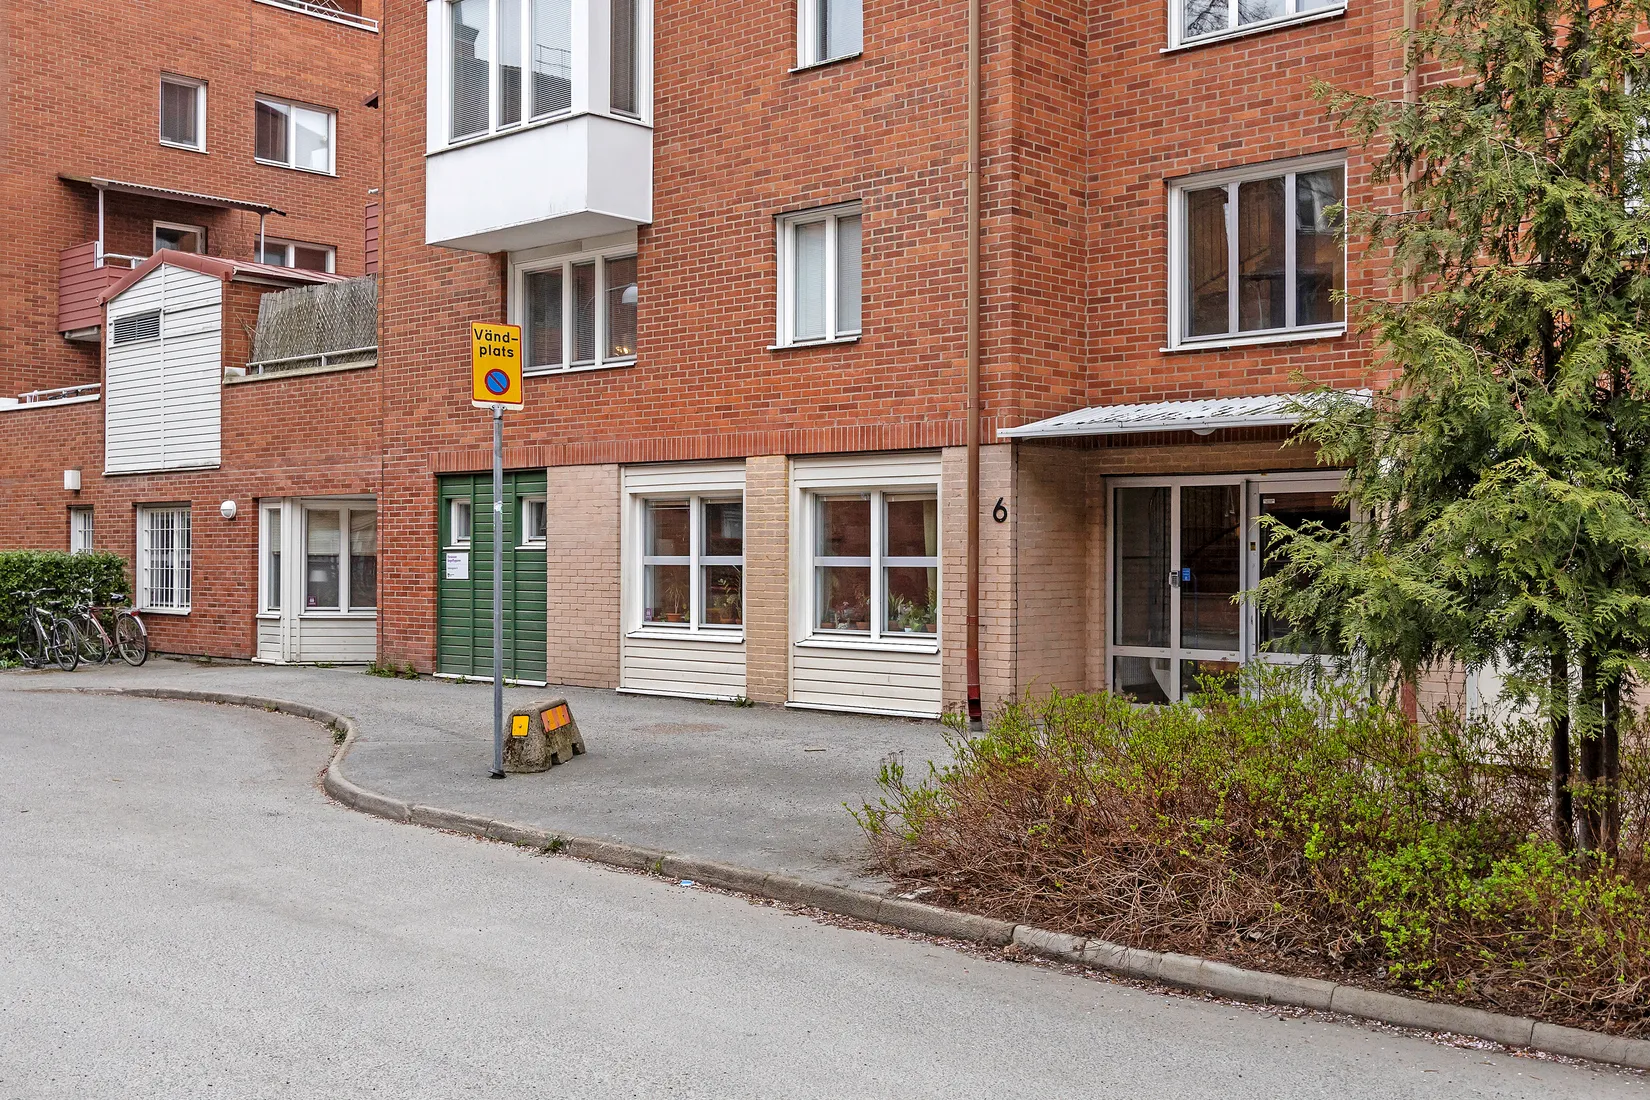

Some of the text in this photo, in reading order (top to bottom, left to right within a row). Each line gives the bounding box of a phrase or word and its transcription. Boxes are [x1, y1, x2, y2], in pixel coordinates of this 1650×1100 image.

[473, 328, 519, 343] Vänd-
[479, 344, 514, 358] plats
[993, 497, 1007, 523] 6
